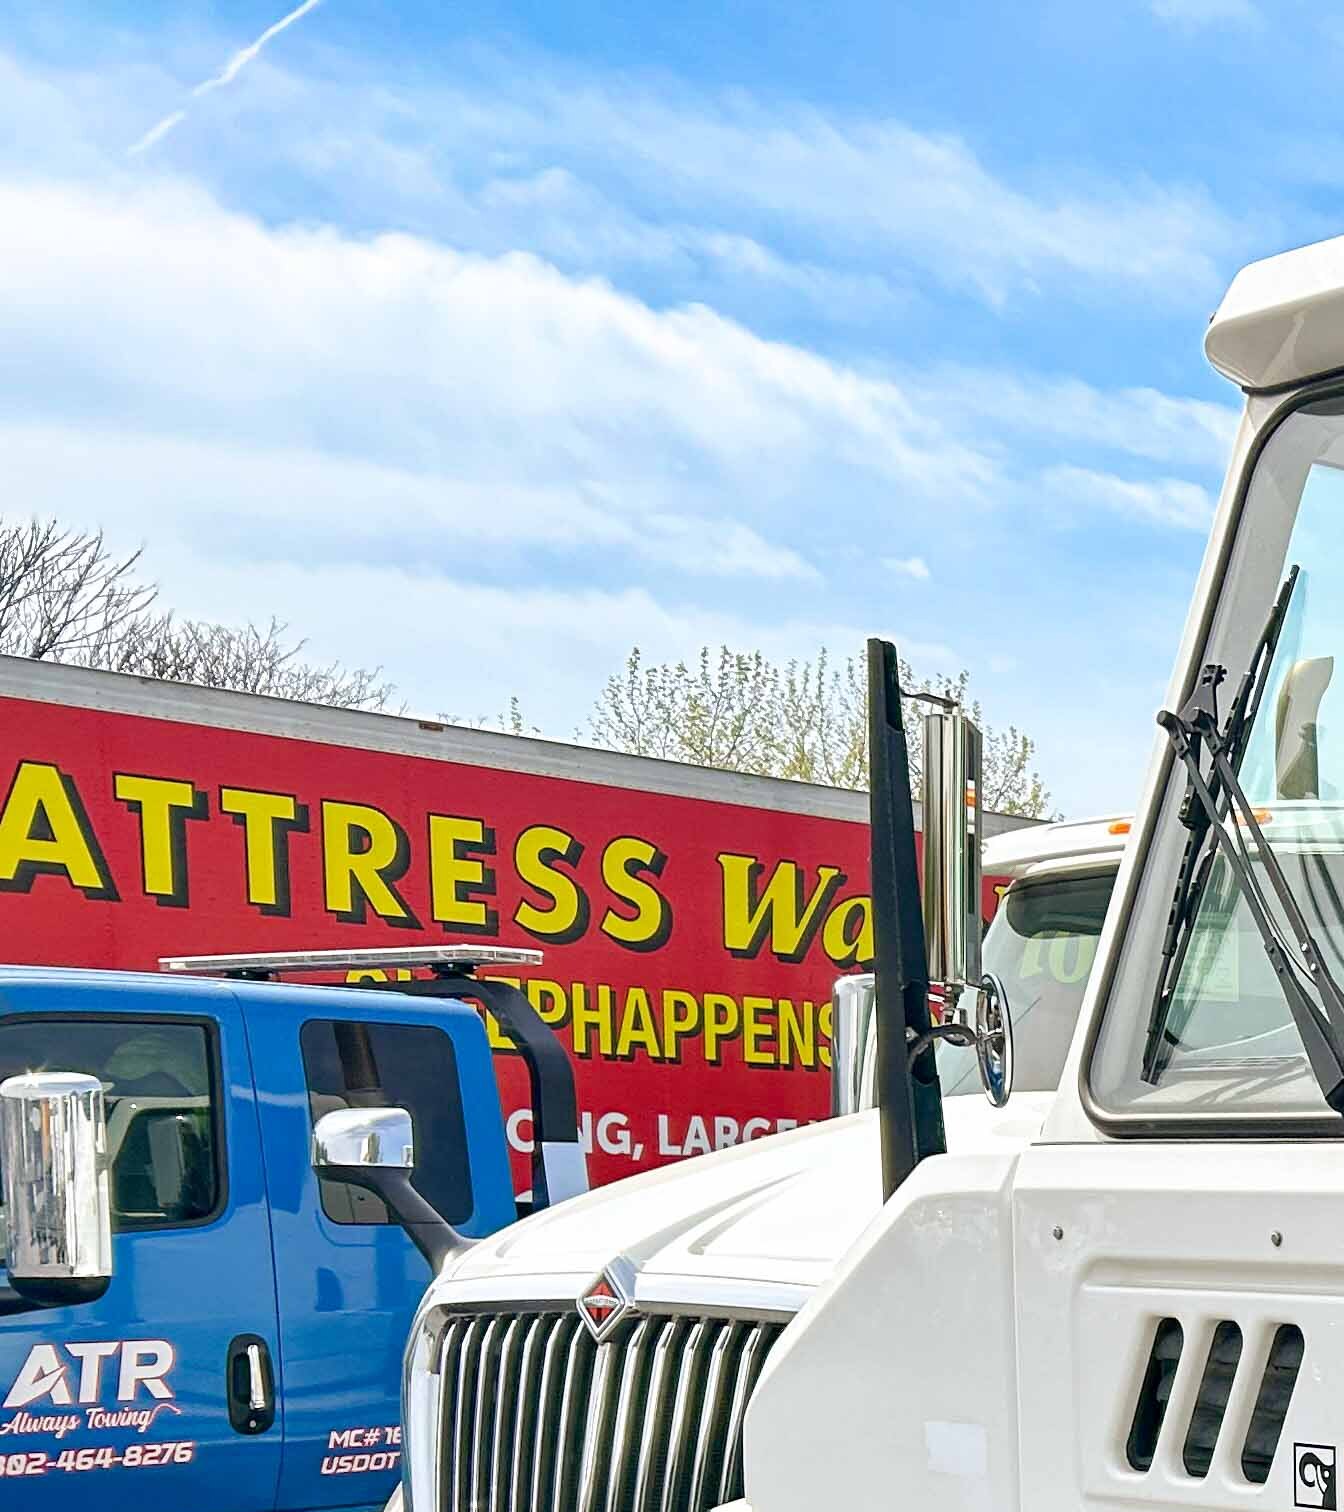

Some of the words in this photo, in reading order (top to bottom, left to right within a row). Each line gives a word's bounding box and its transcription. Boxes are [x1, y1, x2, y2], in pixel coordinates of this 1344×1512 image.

[0, 759, 670, 950] ATTRESS
[3, 1339, 175, 1407] ATR
[0, 1412, 80, 1439] Always
[86, 1404, 181, 1433] Towing
[321, 1451, 401, 1475] USDOT
